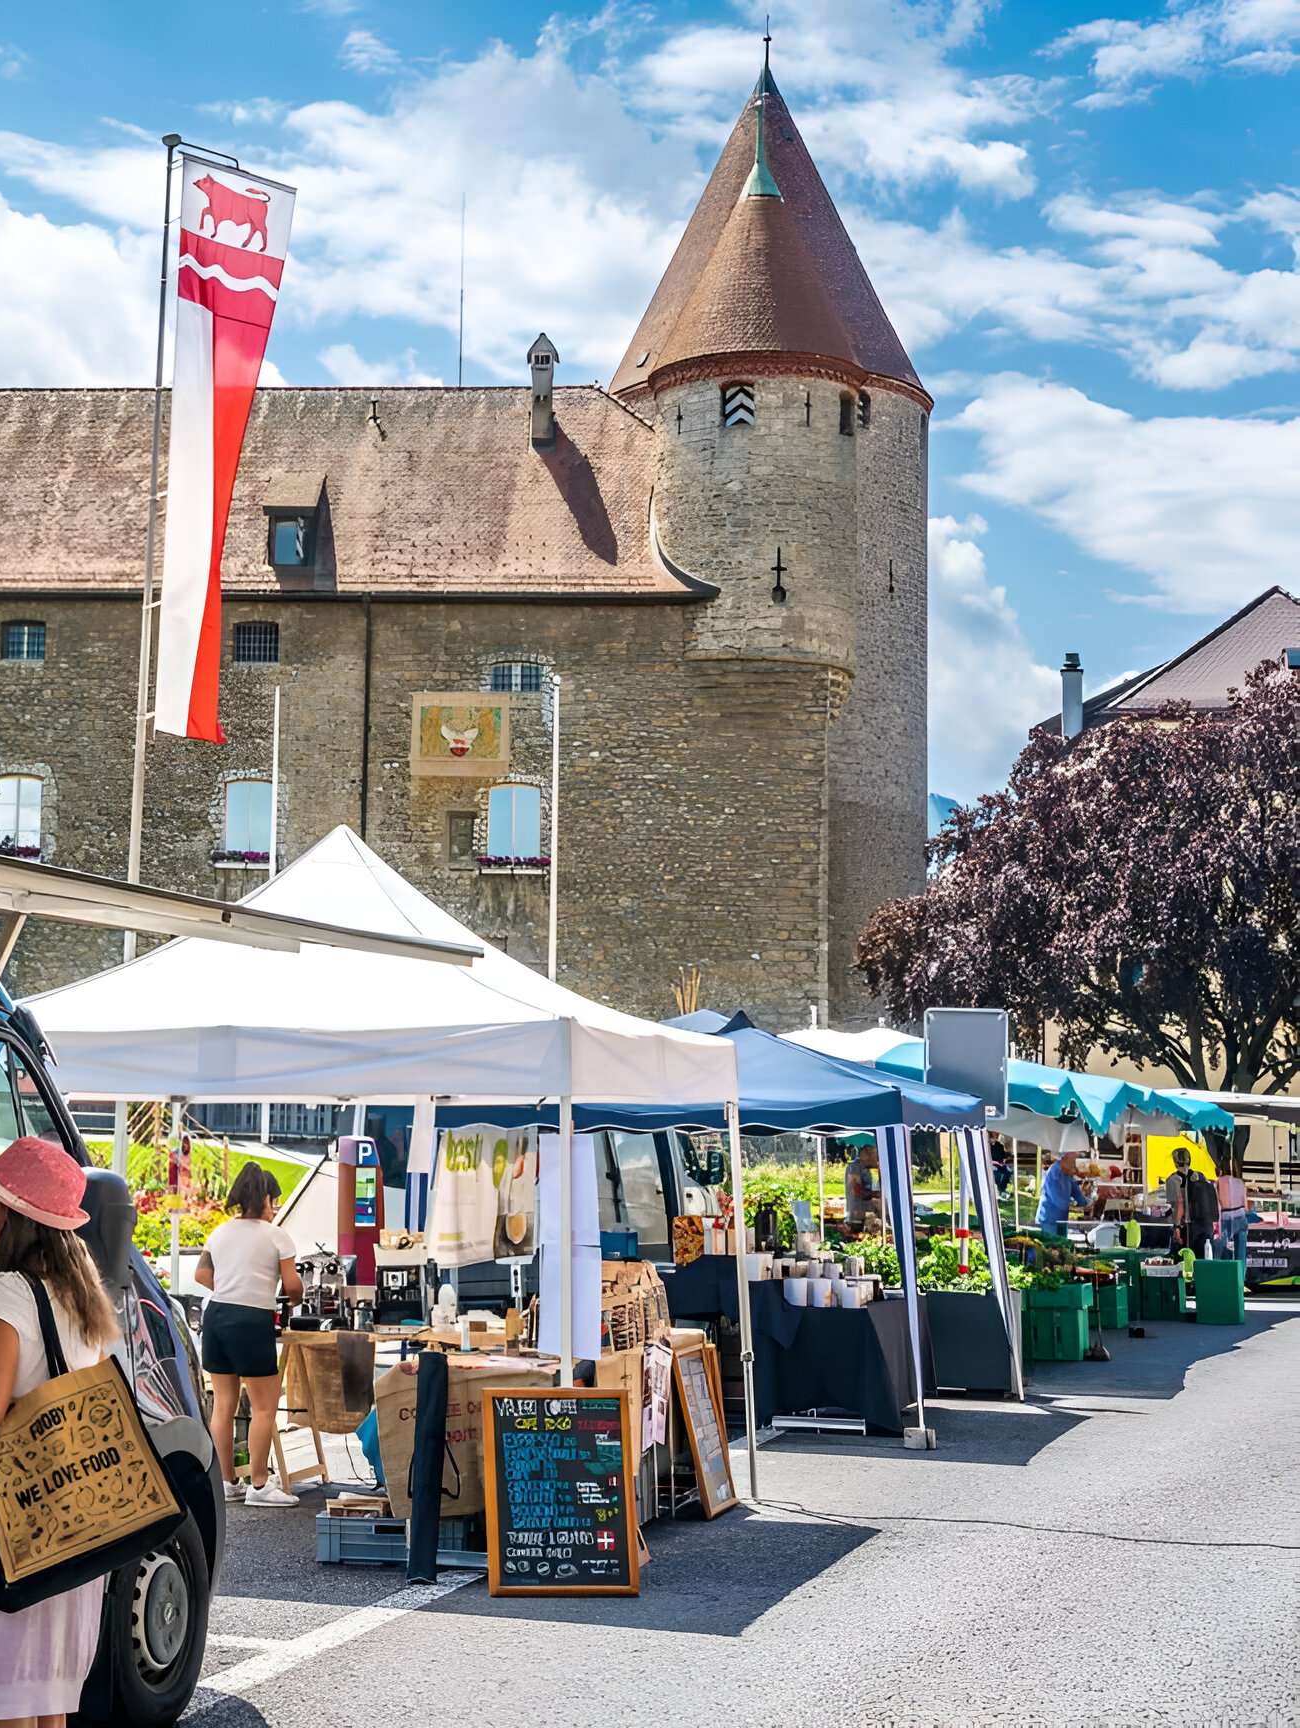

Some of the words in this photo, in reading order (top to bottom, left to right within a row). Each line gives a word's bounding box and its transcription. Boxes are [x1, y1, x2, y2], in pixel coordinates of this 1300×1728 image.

[358, 1143, 373, 1164] P
[29, 1404, 67, 1441] FOOBY
[15, 1483, 43, 1510] WE
[43, 1462, 82, 1495] LOVE
[80, 1446, 121, 1477] FOOD
